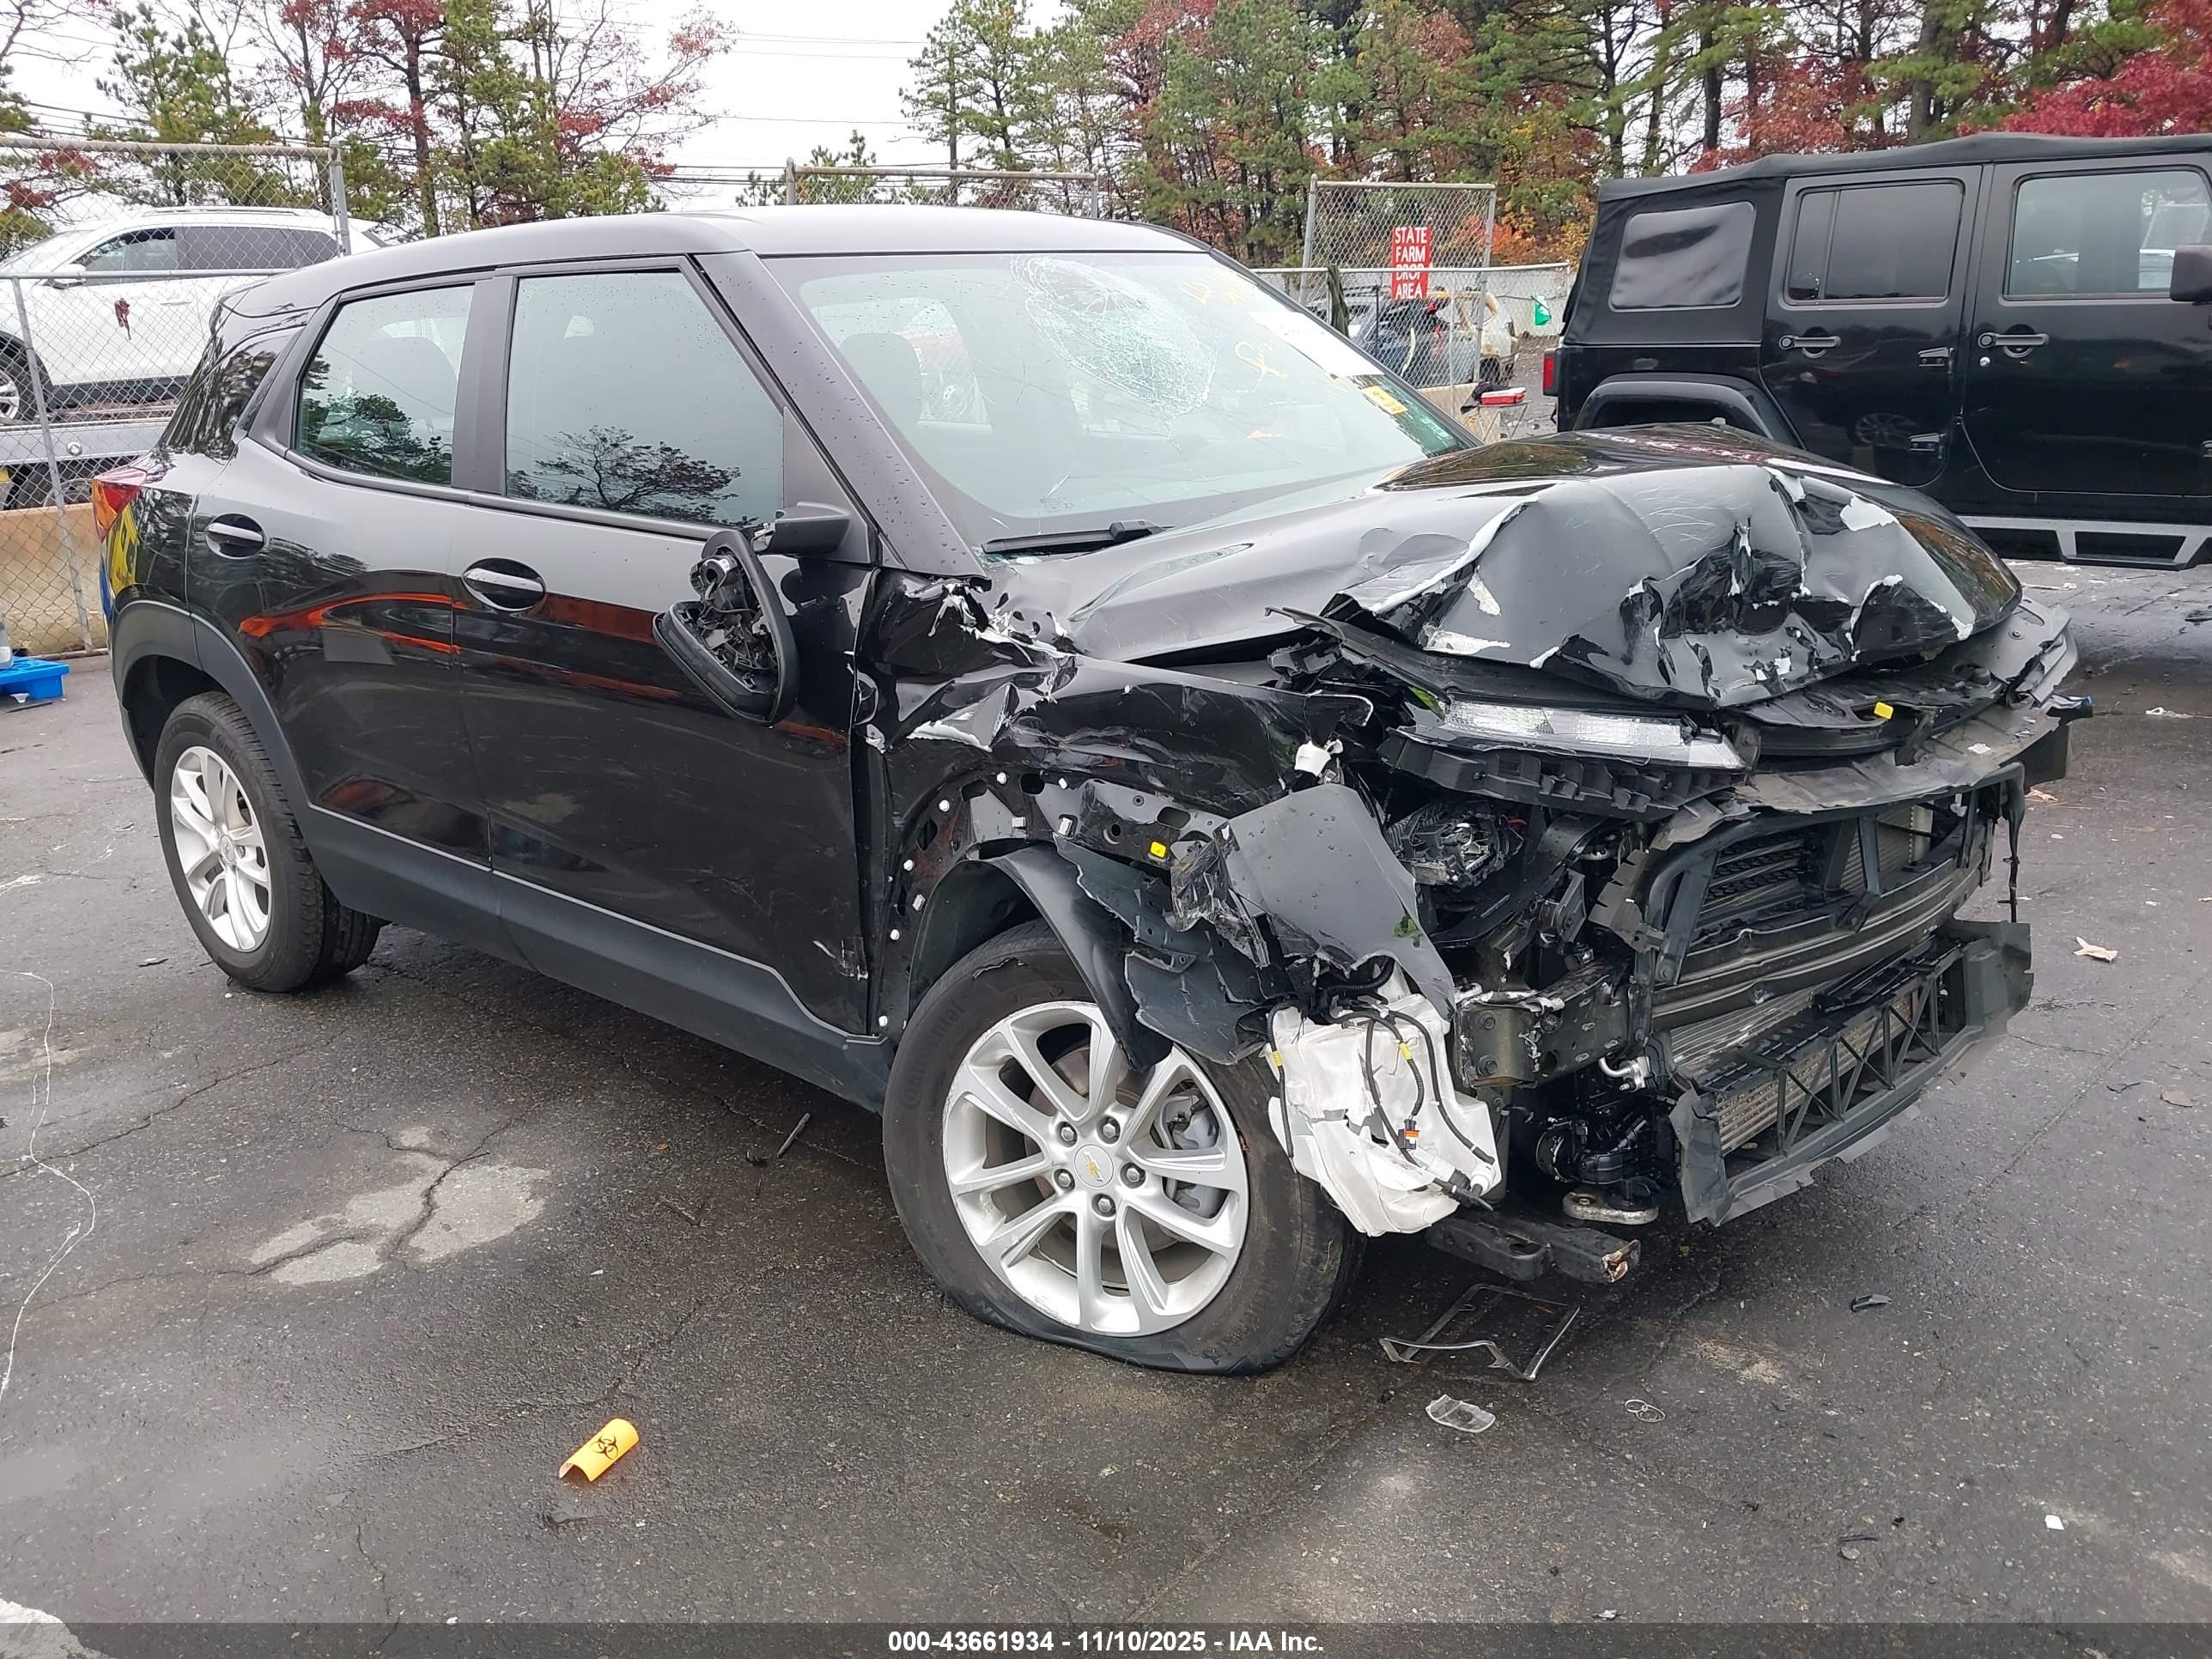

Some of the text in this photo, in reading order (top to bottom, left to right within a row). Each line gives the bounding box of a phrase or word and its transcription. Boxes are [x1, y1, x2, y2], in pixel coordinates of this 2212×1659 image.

[1395, 227, 1428, 244] STATE
[1395, 246, 1426, 263] FARM
[1395, 283, 1423, 300] AREA
